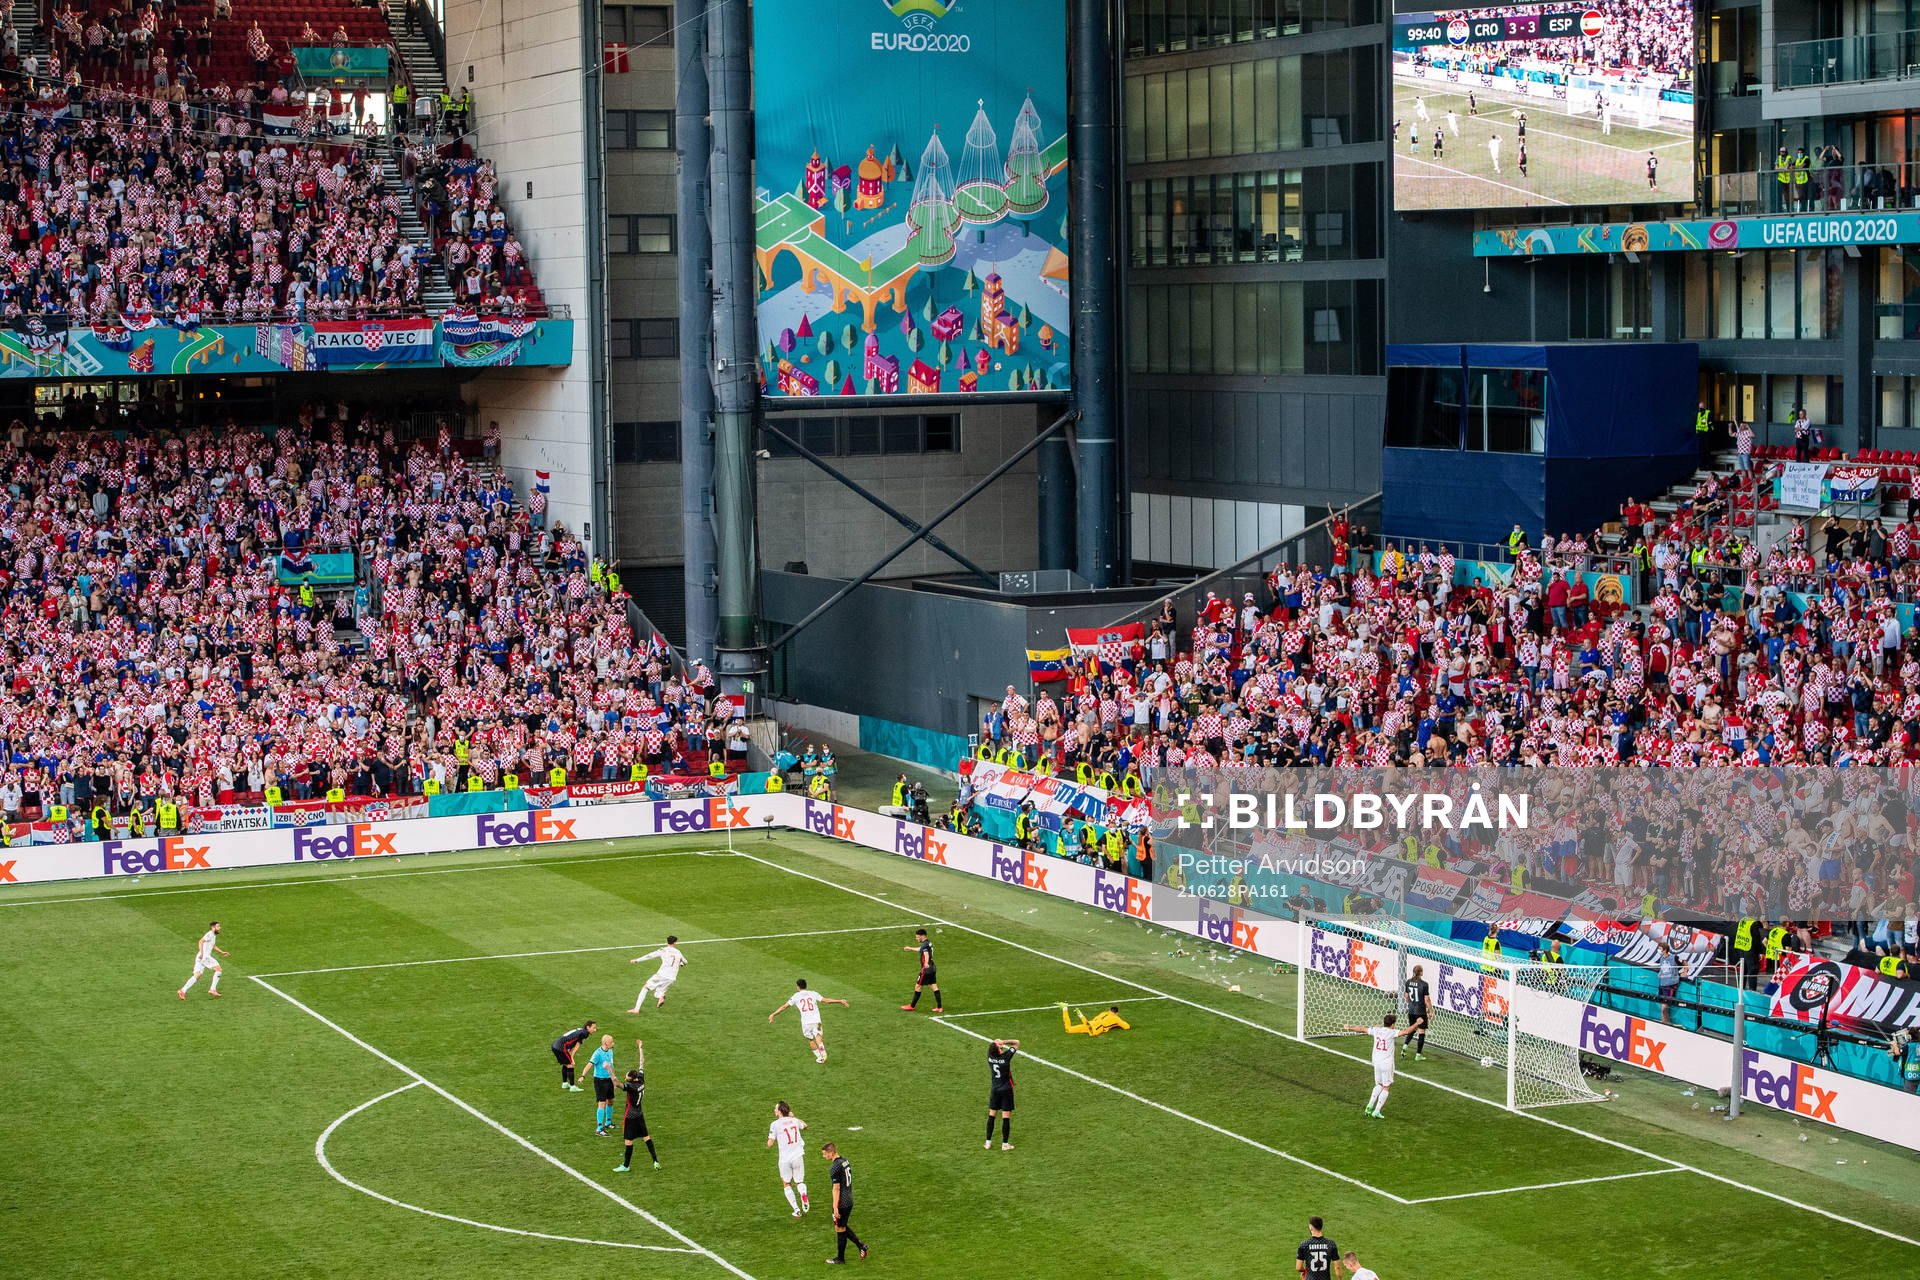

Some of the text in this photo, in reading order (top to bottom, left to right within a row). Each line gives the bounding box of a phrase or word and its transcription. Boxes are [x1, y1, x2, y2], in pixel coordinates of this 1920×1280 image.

[903, 16, 935, 30] UEFA
[1407, 27, 1442, 41] 99:40
[1474, 23, 1499, 37] CRO
[1549, 18, 1573, 32] ESP
[1763, 218, 1898, 244] UEFA EURO 2020
[572, 781, 641, 795] KAMEŠNICA
[220, 817, 268, 831] HRVATSKA
[477, 809, 577, 846] FedEx
[654, 797, 751, 832] FedEx
[805, 798, 856, 841] FedEx
[103, 837, 211, 875] FedEx
[294, 823, 398, 861] FedEx
[895, 820, 948, 865] FedEx
[992, 844, 1049, 892] FedEx
[1093, 869, 1151, 920] FedEx
[1198, 900, 1259, 952] FedEx
[669, 955, 676, 967] 7
[1310, 927, 1380, 987] FedEx
[800, 998, 815, 1013] 26
[1375, 1036, 1388, 1052] 21
[1579, 1004, 1667, 1073] FedEx
[992, 1063, 1001, 1079] 5
[1743, 1051, 1839, 1124] FedEx
[783, 1126, 798, 1145] 17
[1310, 1251, 1328, 1272] 25
